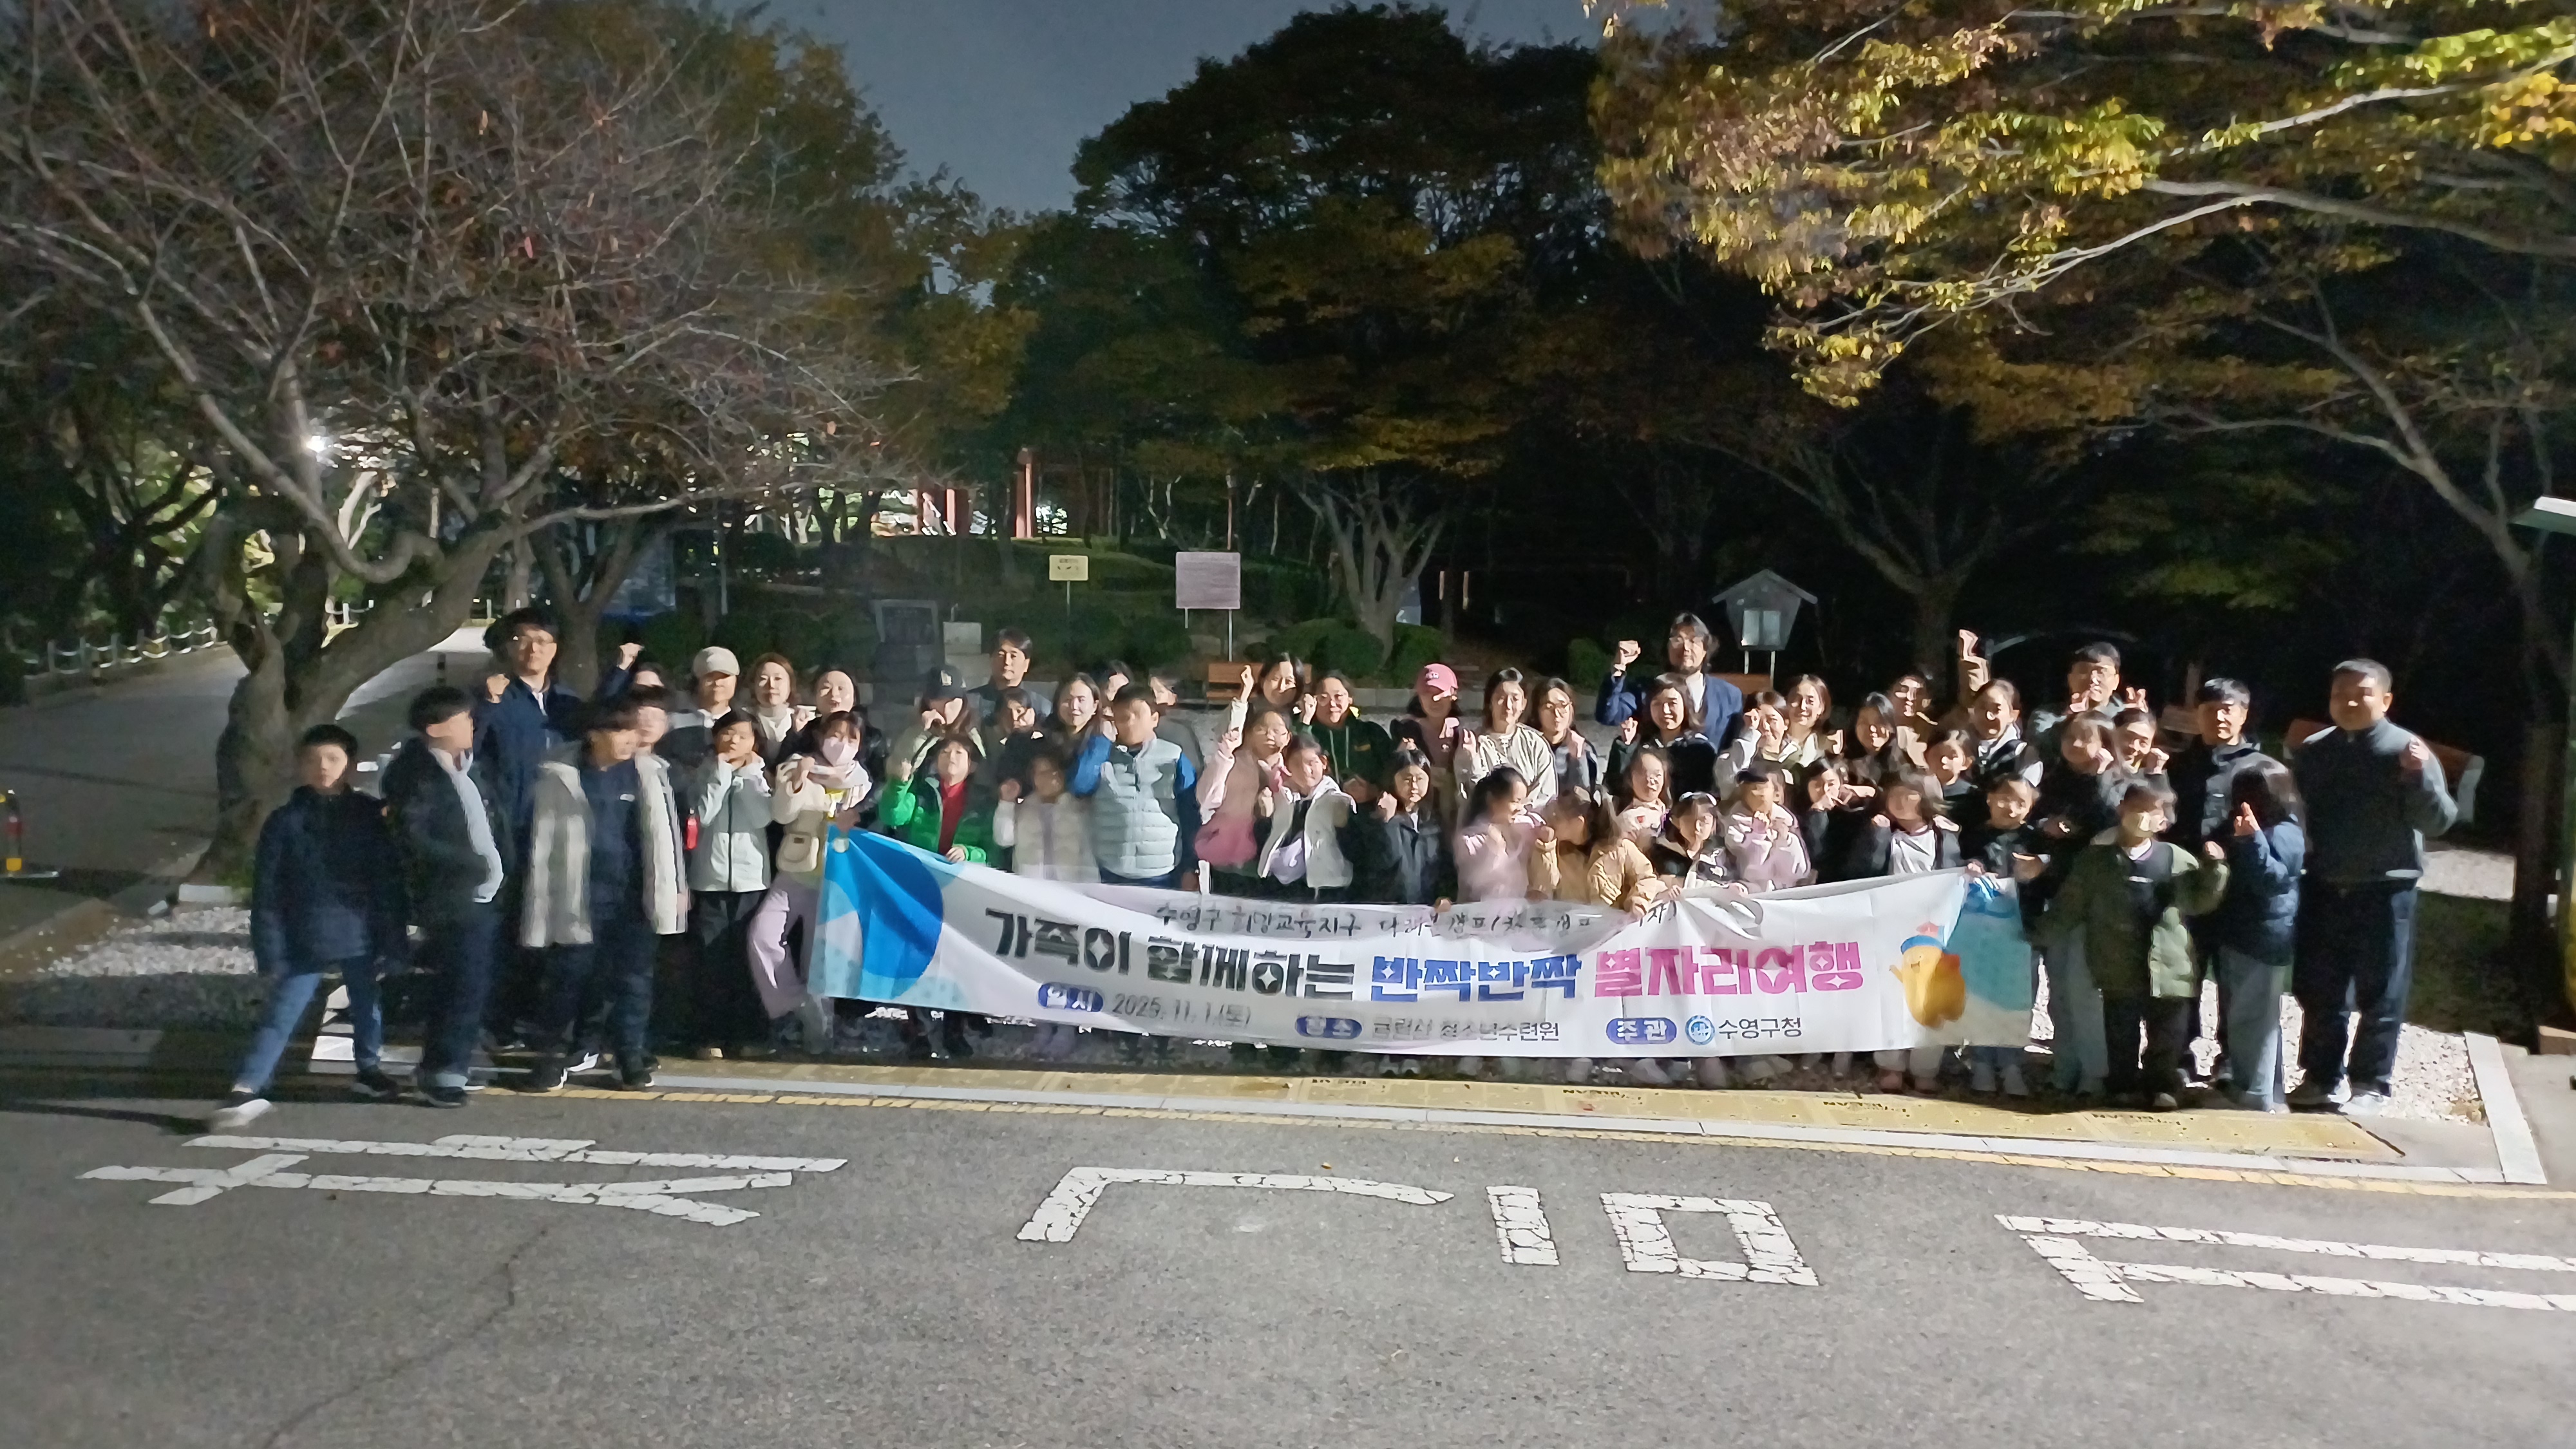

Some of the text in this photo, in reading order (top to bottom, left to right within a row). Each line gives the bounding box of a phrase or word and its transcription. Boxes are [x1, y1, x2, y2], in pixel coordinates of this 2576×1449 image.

[1157, 903, 1221, 931] 수영구
[985, 907, 1864, 1001] 가족이 함께하는 반짝반짝 별자리여행
[1616, 1017, 1803, 1042] 주관 수영구청
